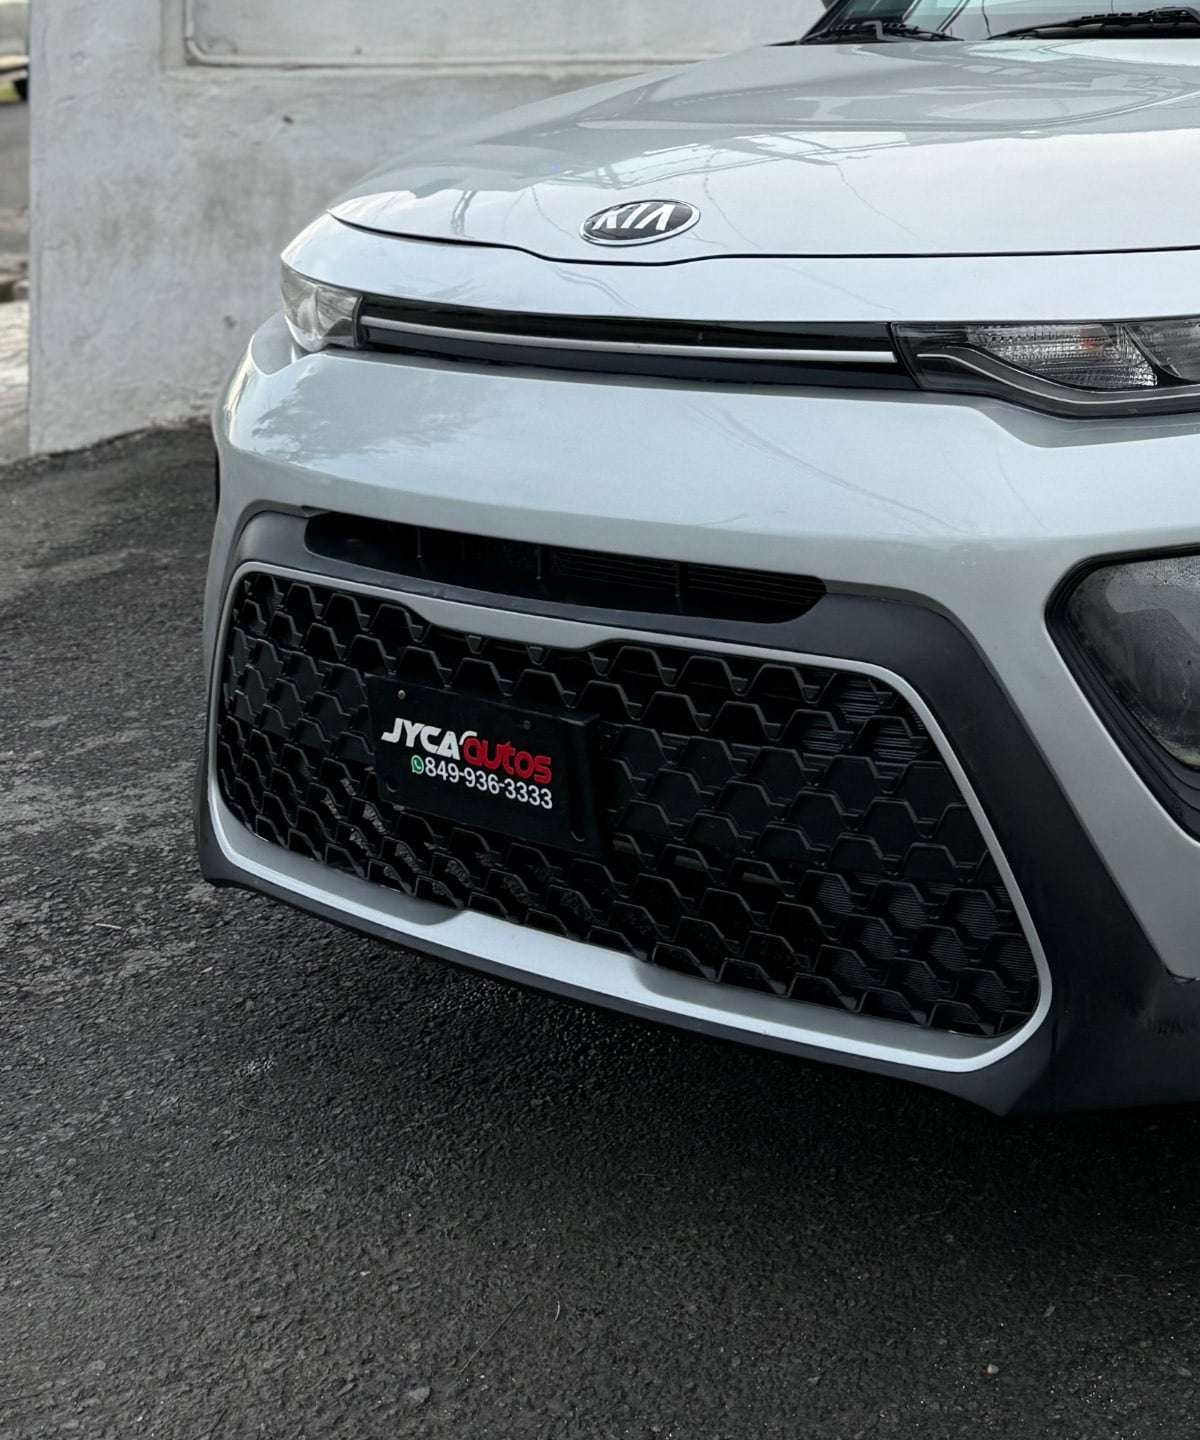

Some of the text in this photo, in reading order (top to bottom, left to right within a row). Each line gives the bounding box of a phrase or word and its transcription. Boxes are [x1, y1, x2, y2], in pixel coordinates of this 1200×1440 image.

[591, 203, 676, 231] KIA
[381, 717, 460, 760] JYCA
[424, 756, 553, 810] 849-936-3333
